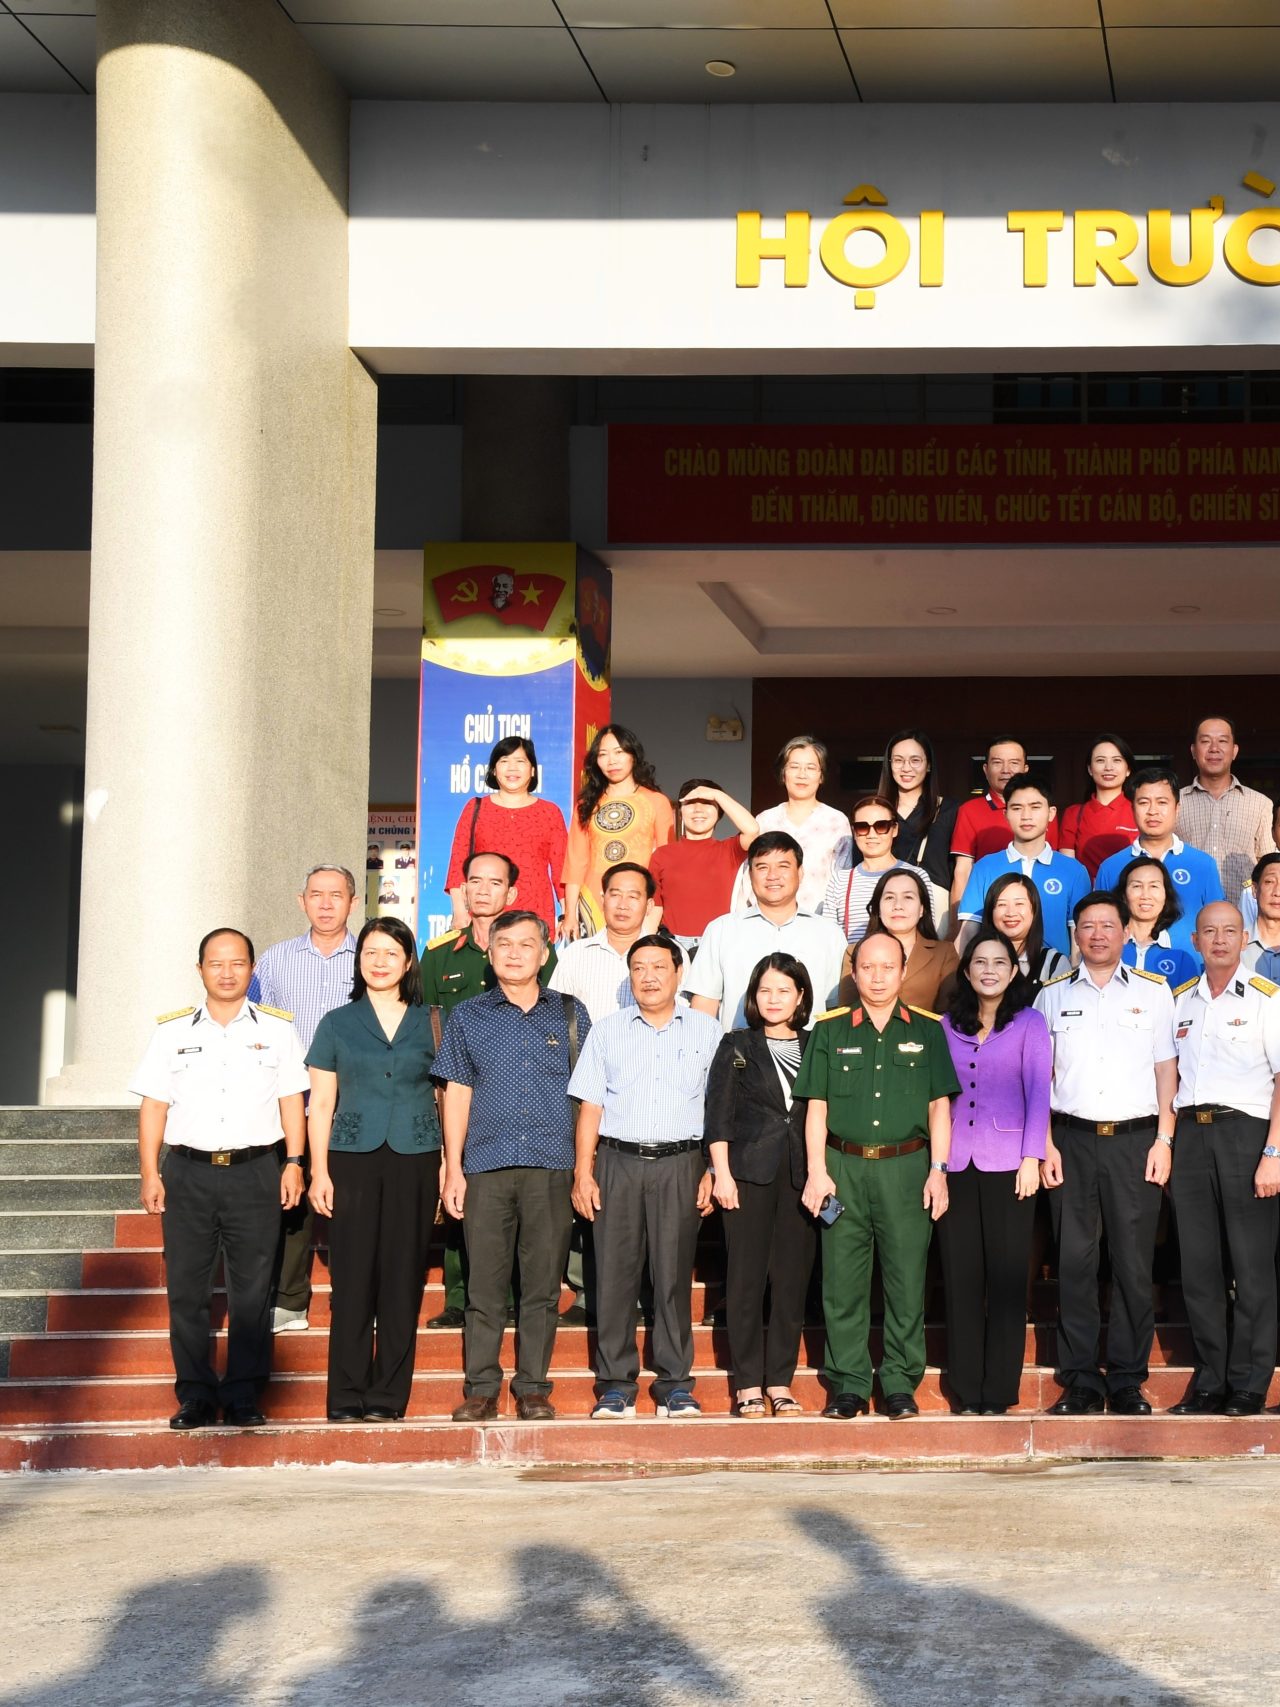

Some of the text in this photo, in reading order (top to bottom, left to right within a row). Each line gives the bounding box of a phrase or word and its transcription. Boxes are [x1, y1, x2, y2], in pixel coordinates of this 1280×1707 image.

[736, 184, 945, 310] HỘI
[665, 443, 720, 476] CHÀO
[728, 443, 789, 476] MỪNG
[797, 443, 854, 476] ĐOÀN
[861, 448, 895, 482] ĐẠI
[902, 438, 948, 476] BIỂU
[956, 443, 996, 476] CÁC
[1004, 440, 1056, 479] TỈNH,
[1064, 442, 1132, 476] THÀNH
[1140, 438, 1180, 475] PHỐ
[1188, 442, 1235, 475] PHÍA
[752, 486, 793, 523] ĐẾN
[800, 489, 864, 526] THĂM,
[871, 489, 928, 528] ĐỘNG
[936, 488, 988, 525] VIÊN,
[996, 488, 1050, 522] CHÚC
[1058, 486, 1092, 522] TẾT
[1099, 488, 1141, 522] CÁN
[1149, 488, 1182, 528] BỘ,
[1190, 485, 1251, 521] CHIẾN
[1259, 488, 1278, 520] SĨ
[464, 704, 495, 744] CHỦ
